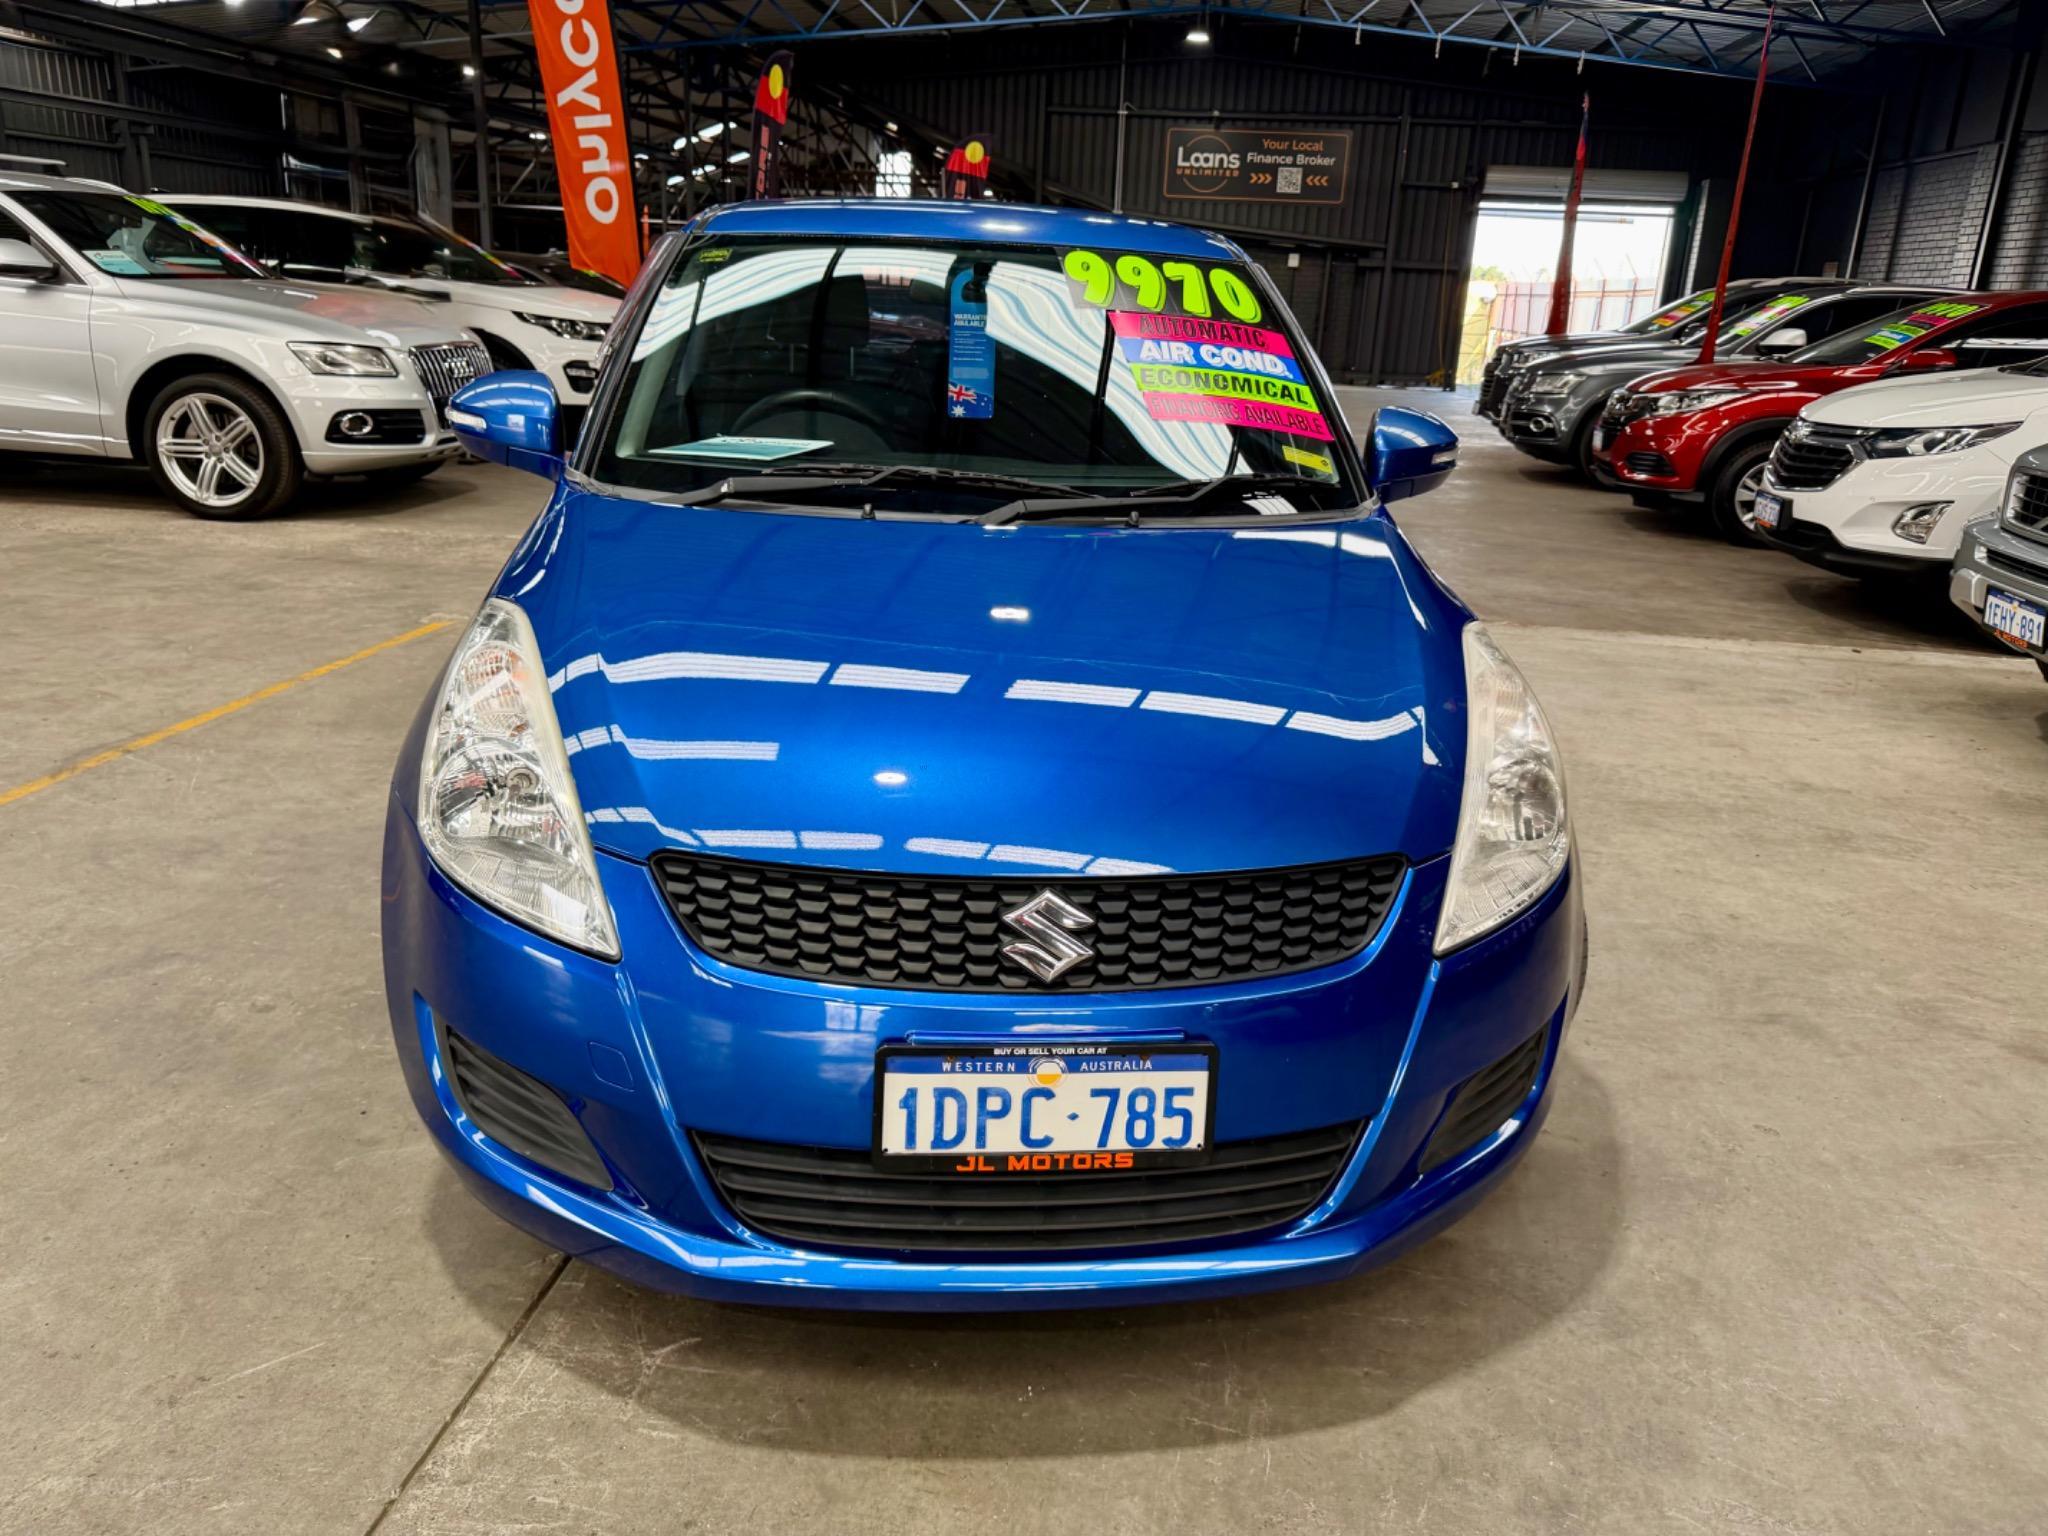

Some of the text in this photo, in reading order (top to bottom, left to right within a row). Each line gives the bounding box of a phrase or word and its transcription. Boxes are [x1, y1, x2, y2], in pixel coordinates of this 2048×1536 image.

[1262, 138, 1323, 151] Your Local
[1176, 146, 1241, 169] Loans
[1246, 152, 1336, 166] Finance Broker
[1176, 168, 1240, 177] UNLIMITED
[1063, 250, 1262, 324] 9970
[1139, 314, 1266, 348] AUTOMATIC
[1139, 339, 1294, 379] AIR COND.
[1140, 367, 1309, 406] ECONOMICAL
[1150, 396, 1324, 434] FINANCING AVAILABLE
[1052, 1047, 1075, 1055] YOUR
[1077, 1047, 1096, 1055] CAR
[1096, 1047, 1108, 1055] AT
[941, 1059, 1153, 1073] WESTERN AUSTRALIA
[956, 1152, 1134, 1172] JL MOTORS
